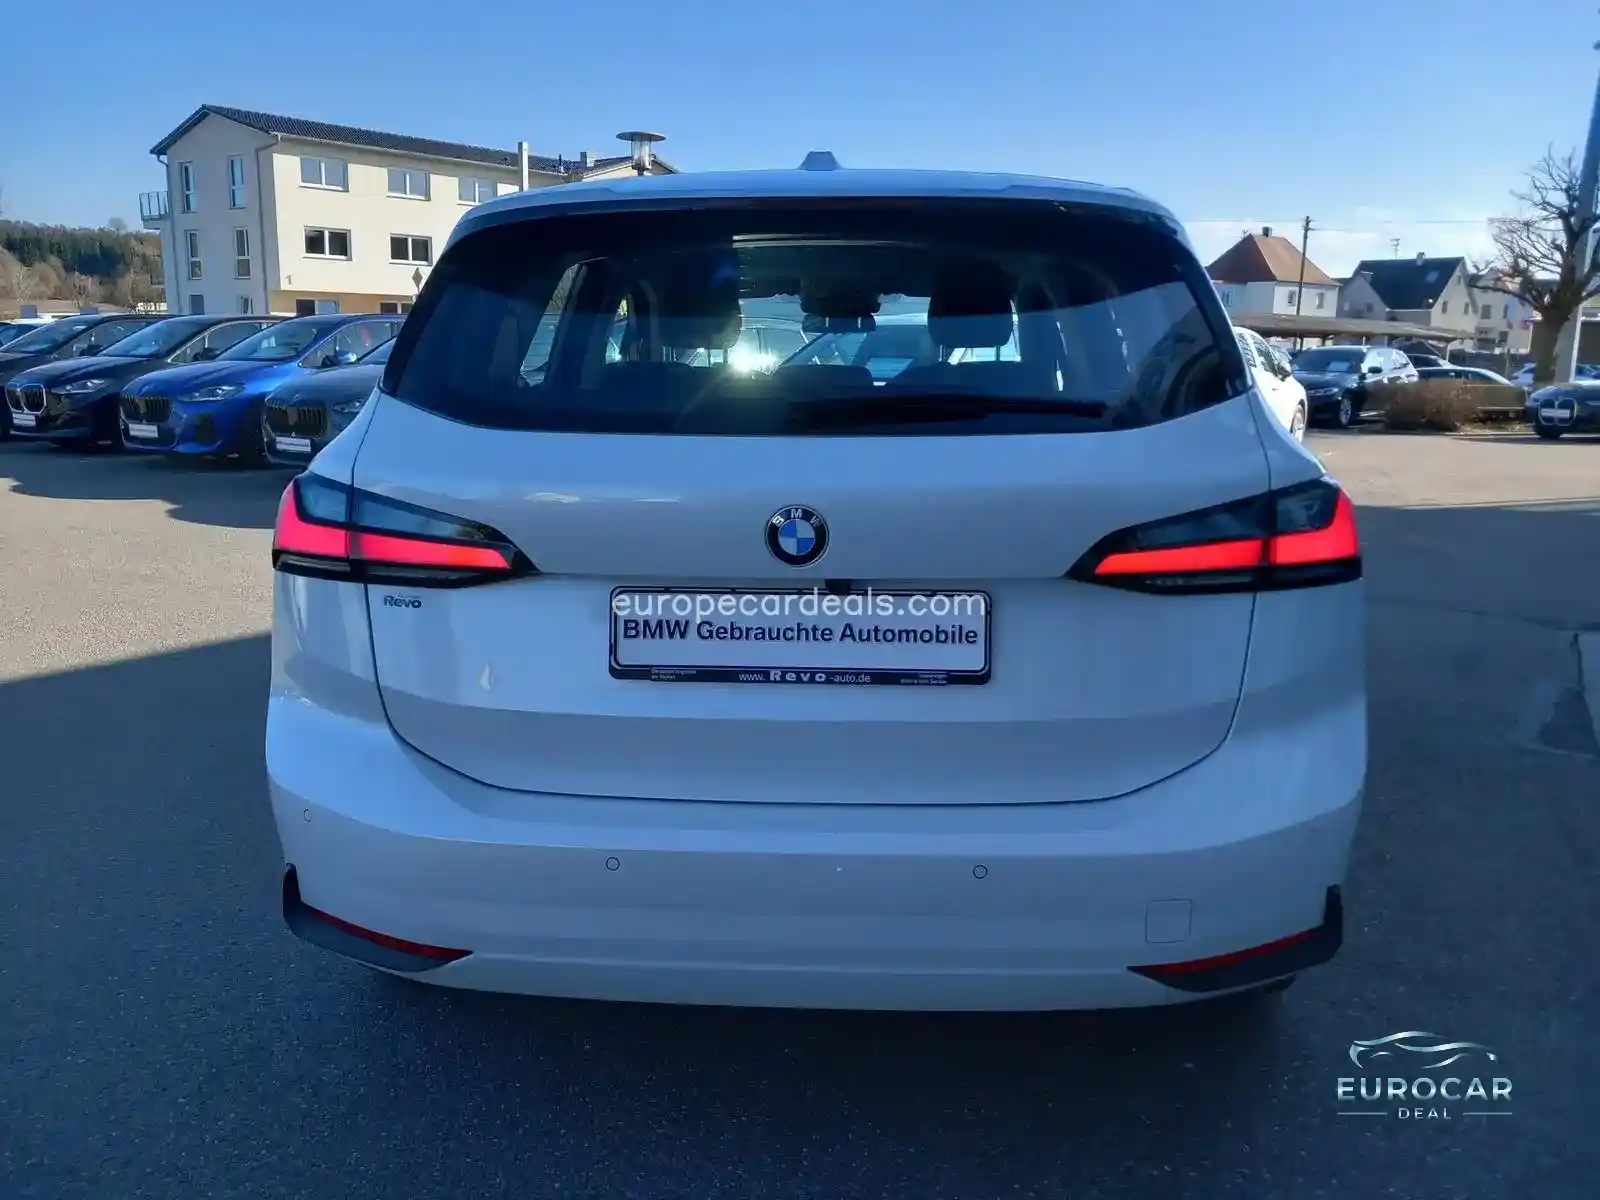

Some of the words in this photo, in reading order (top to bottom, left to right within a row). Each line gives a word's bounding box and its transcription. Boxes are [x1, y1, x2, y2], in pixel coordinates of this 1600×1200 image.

[772, 508, 822, 527] BMW
[383, 595, 422, 609] Revo
[623, 619, 690, 640] BMW
[696, 620, 833, 643] Gebrauchte
[839, 622, 978, 645] Automobile
[769, 670, 827, 682] Revo
